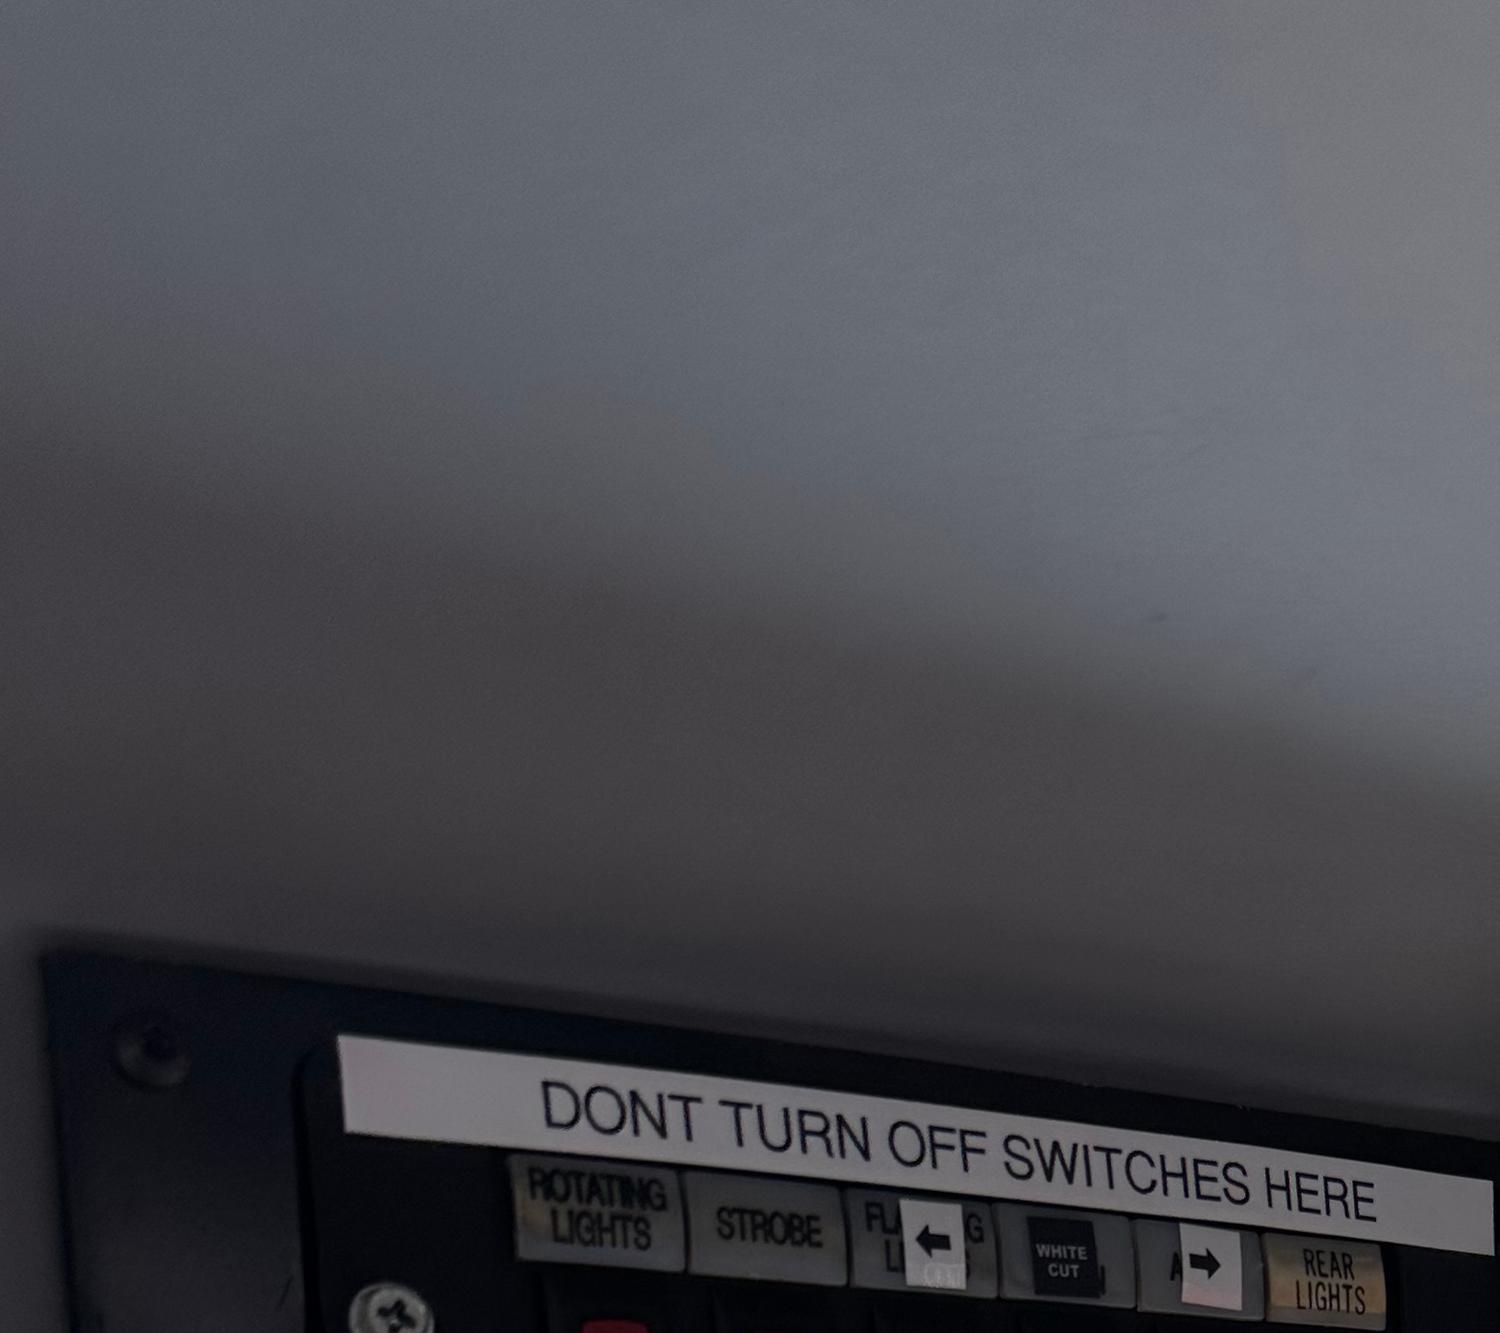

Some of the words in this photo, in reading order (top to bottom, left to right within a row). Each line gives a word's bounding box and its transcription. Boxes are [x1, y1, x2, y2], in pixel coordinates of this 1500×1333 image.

[541, 1080, 702, 1142] DONT
[719, 1100, 871, 1162] TURN
[888, 1120, 986, 1172] OFF
[1003, 1134, 1250, 1205] SWITCHES
[1264, 1166, 1378, 1222] HERE
[528, 1166, 667, 1211] ROTATING
[550, 1209, 652, 1251] LIGHTS
[716, 1207, 823, 1248] STROBE
[1035, 1242, 1088, 1262] WHITE
[1047, 1262, 1080, 1280] CUT
[1303, 1247, 1355, 1281] REAR
[1296, 1280, 1366, 1317] LIGHTS
